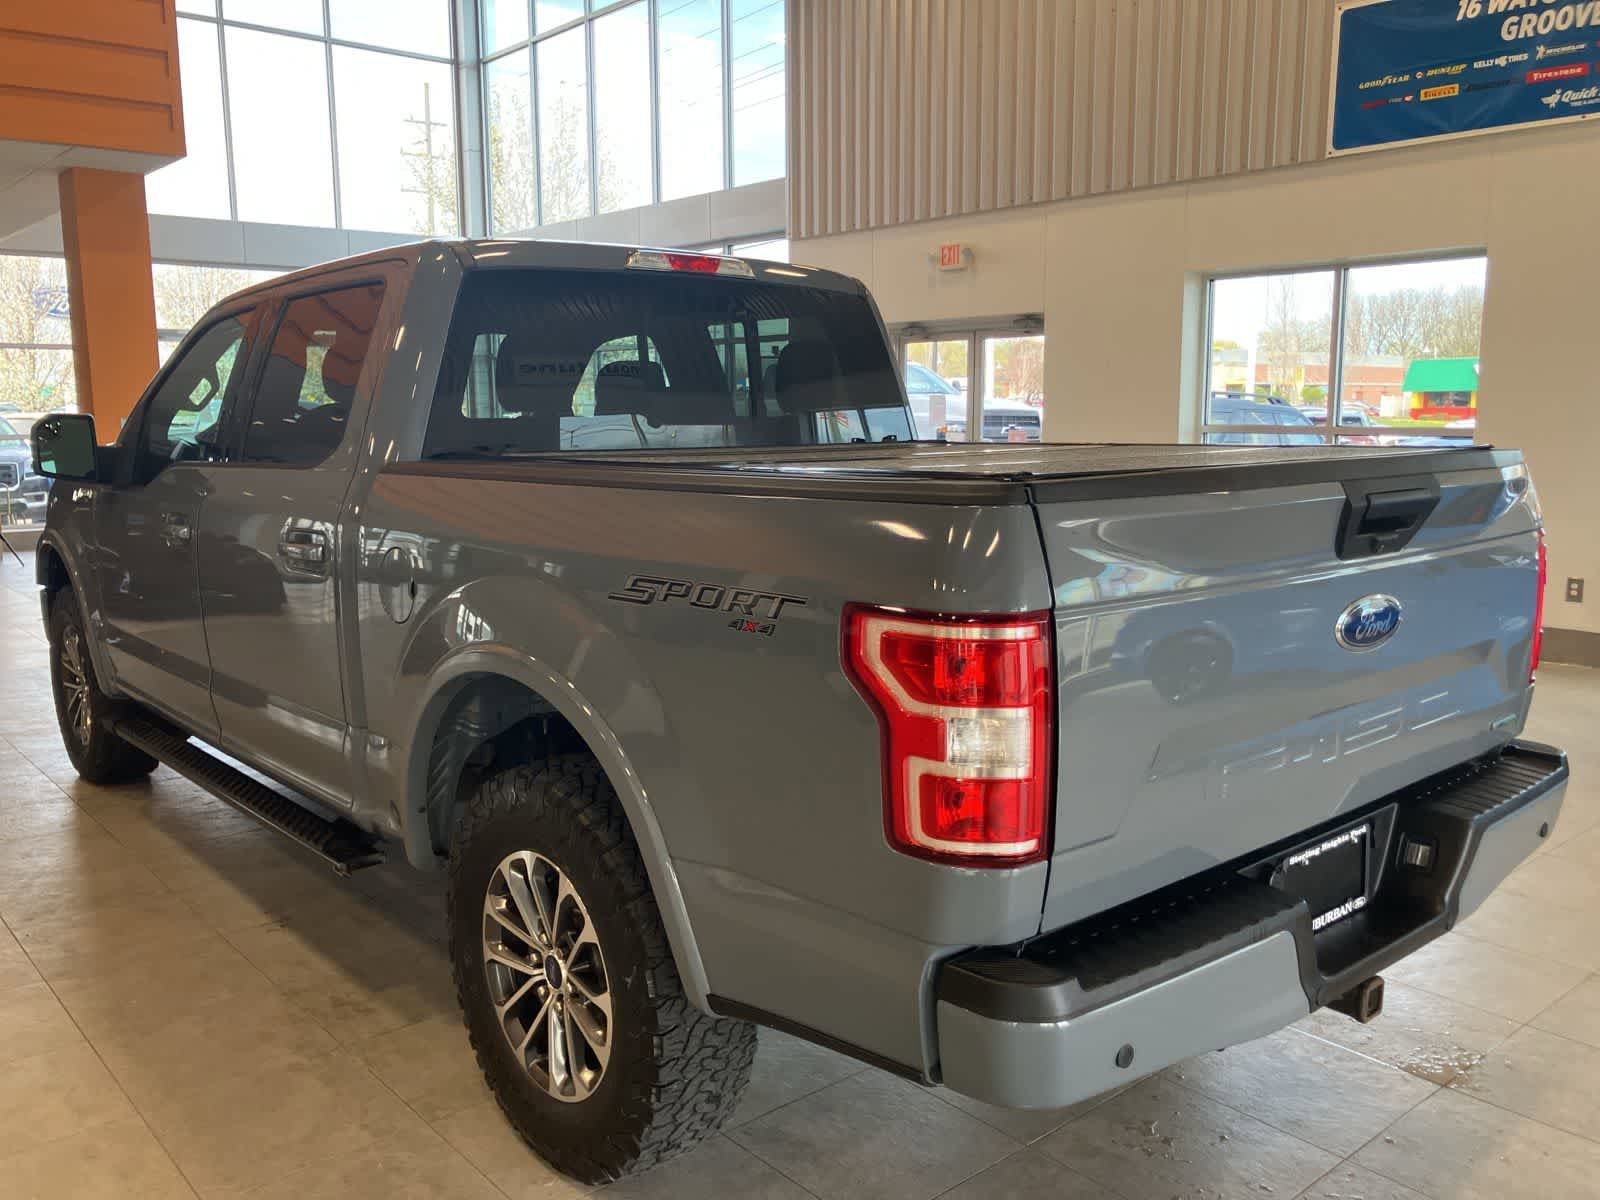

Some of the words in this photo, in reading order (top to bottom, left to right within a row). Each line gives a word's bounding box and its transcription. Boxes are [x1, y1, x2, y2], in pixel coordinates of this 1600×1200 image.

[1456, 0, 1482, 21] 16
[1358, 75, 1410, 90] GOODYEAR
[1533, 66, 1583, 80] Firestone
[1561, 86, 1599, 103] Quick
[940, 244, 960, 267] EXIT
[608, 573, 809, 620] SPORT
[1312, 900, 1353, 931] BURBAN
